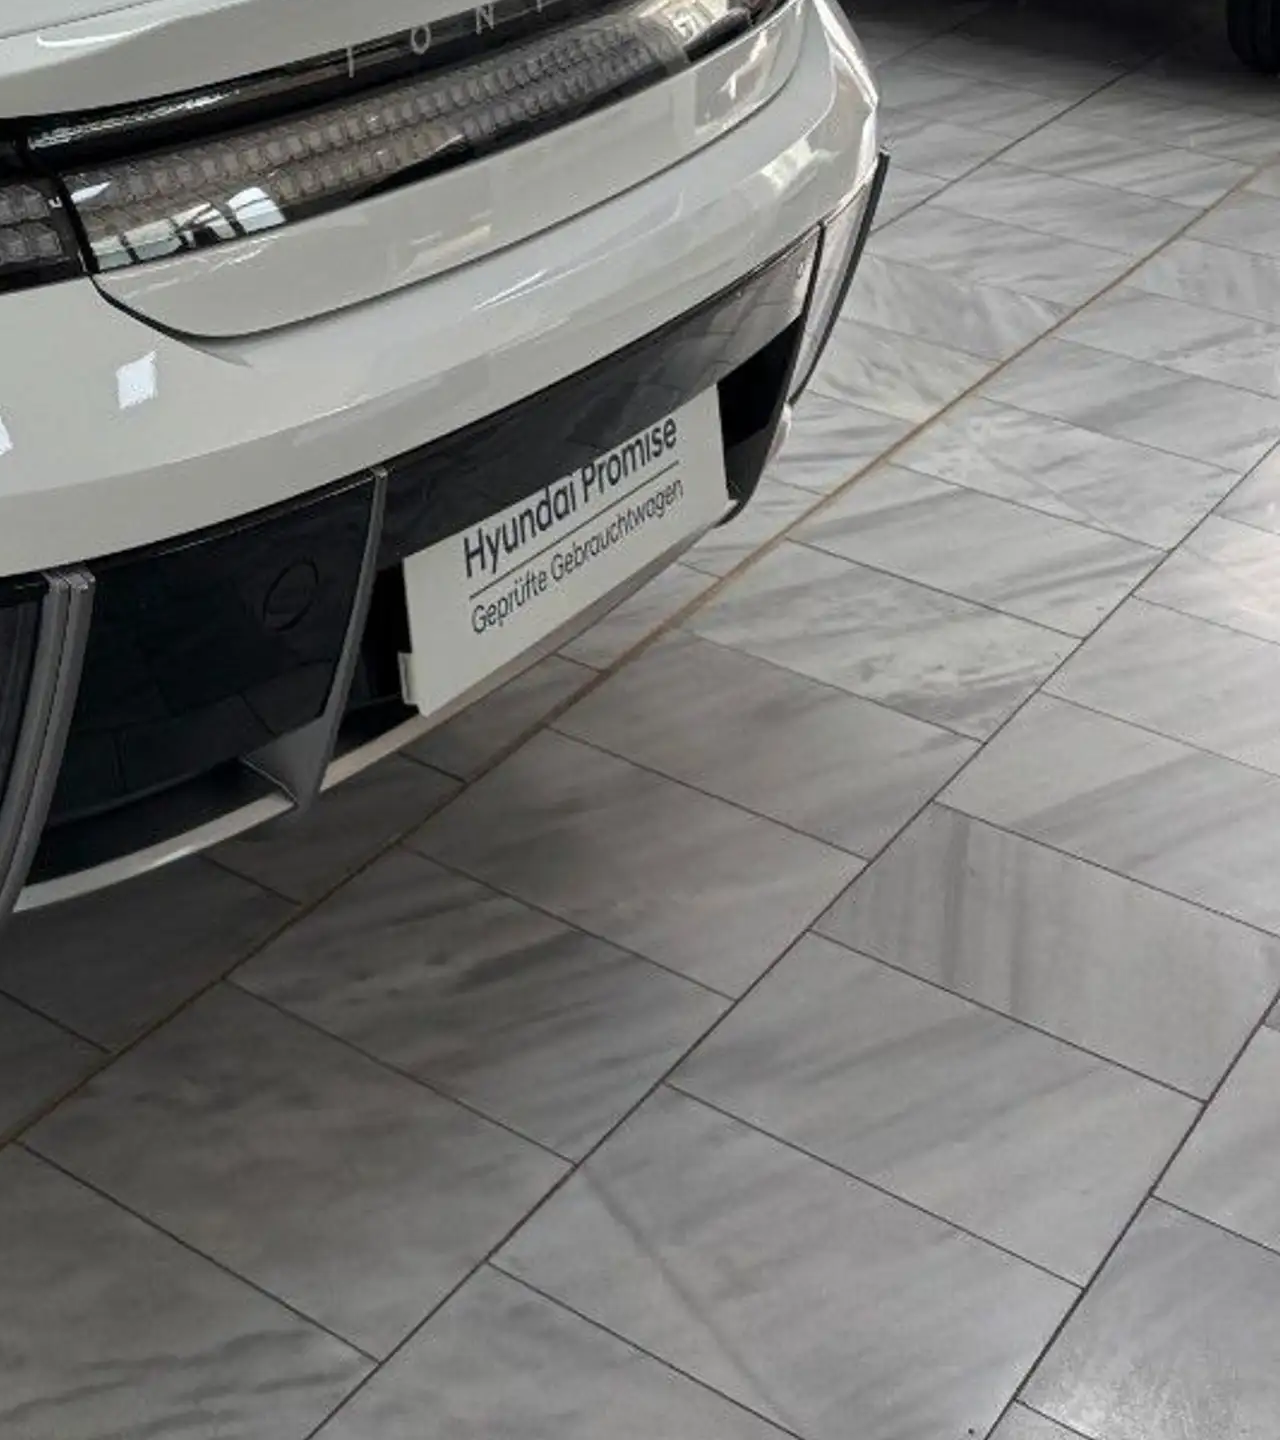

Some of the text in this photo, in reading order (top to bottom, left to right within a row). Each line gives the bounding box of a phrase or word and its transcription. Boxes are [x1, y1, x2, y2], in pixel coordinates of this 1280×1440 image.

[462, 416, 677, 579] Hyundai Promise
[471, 480, 684, 635] Geprüfte Gebrauchtwagen
